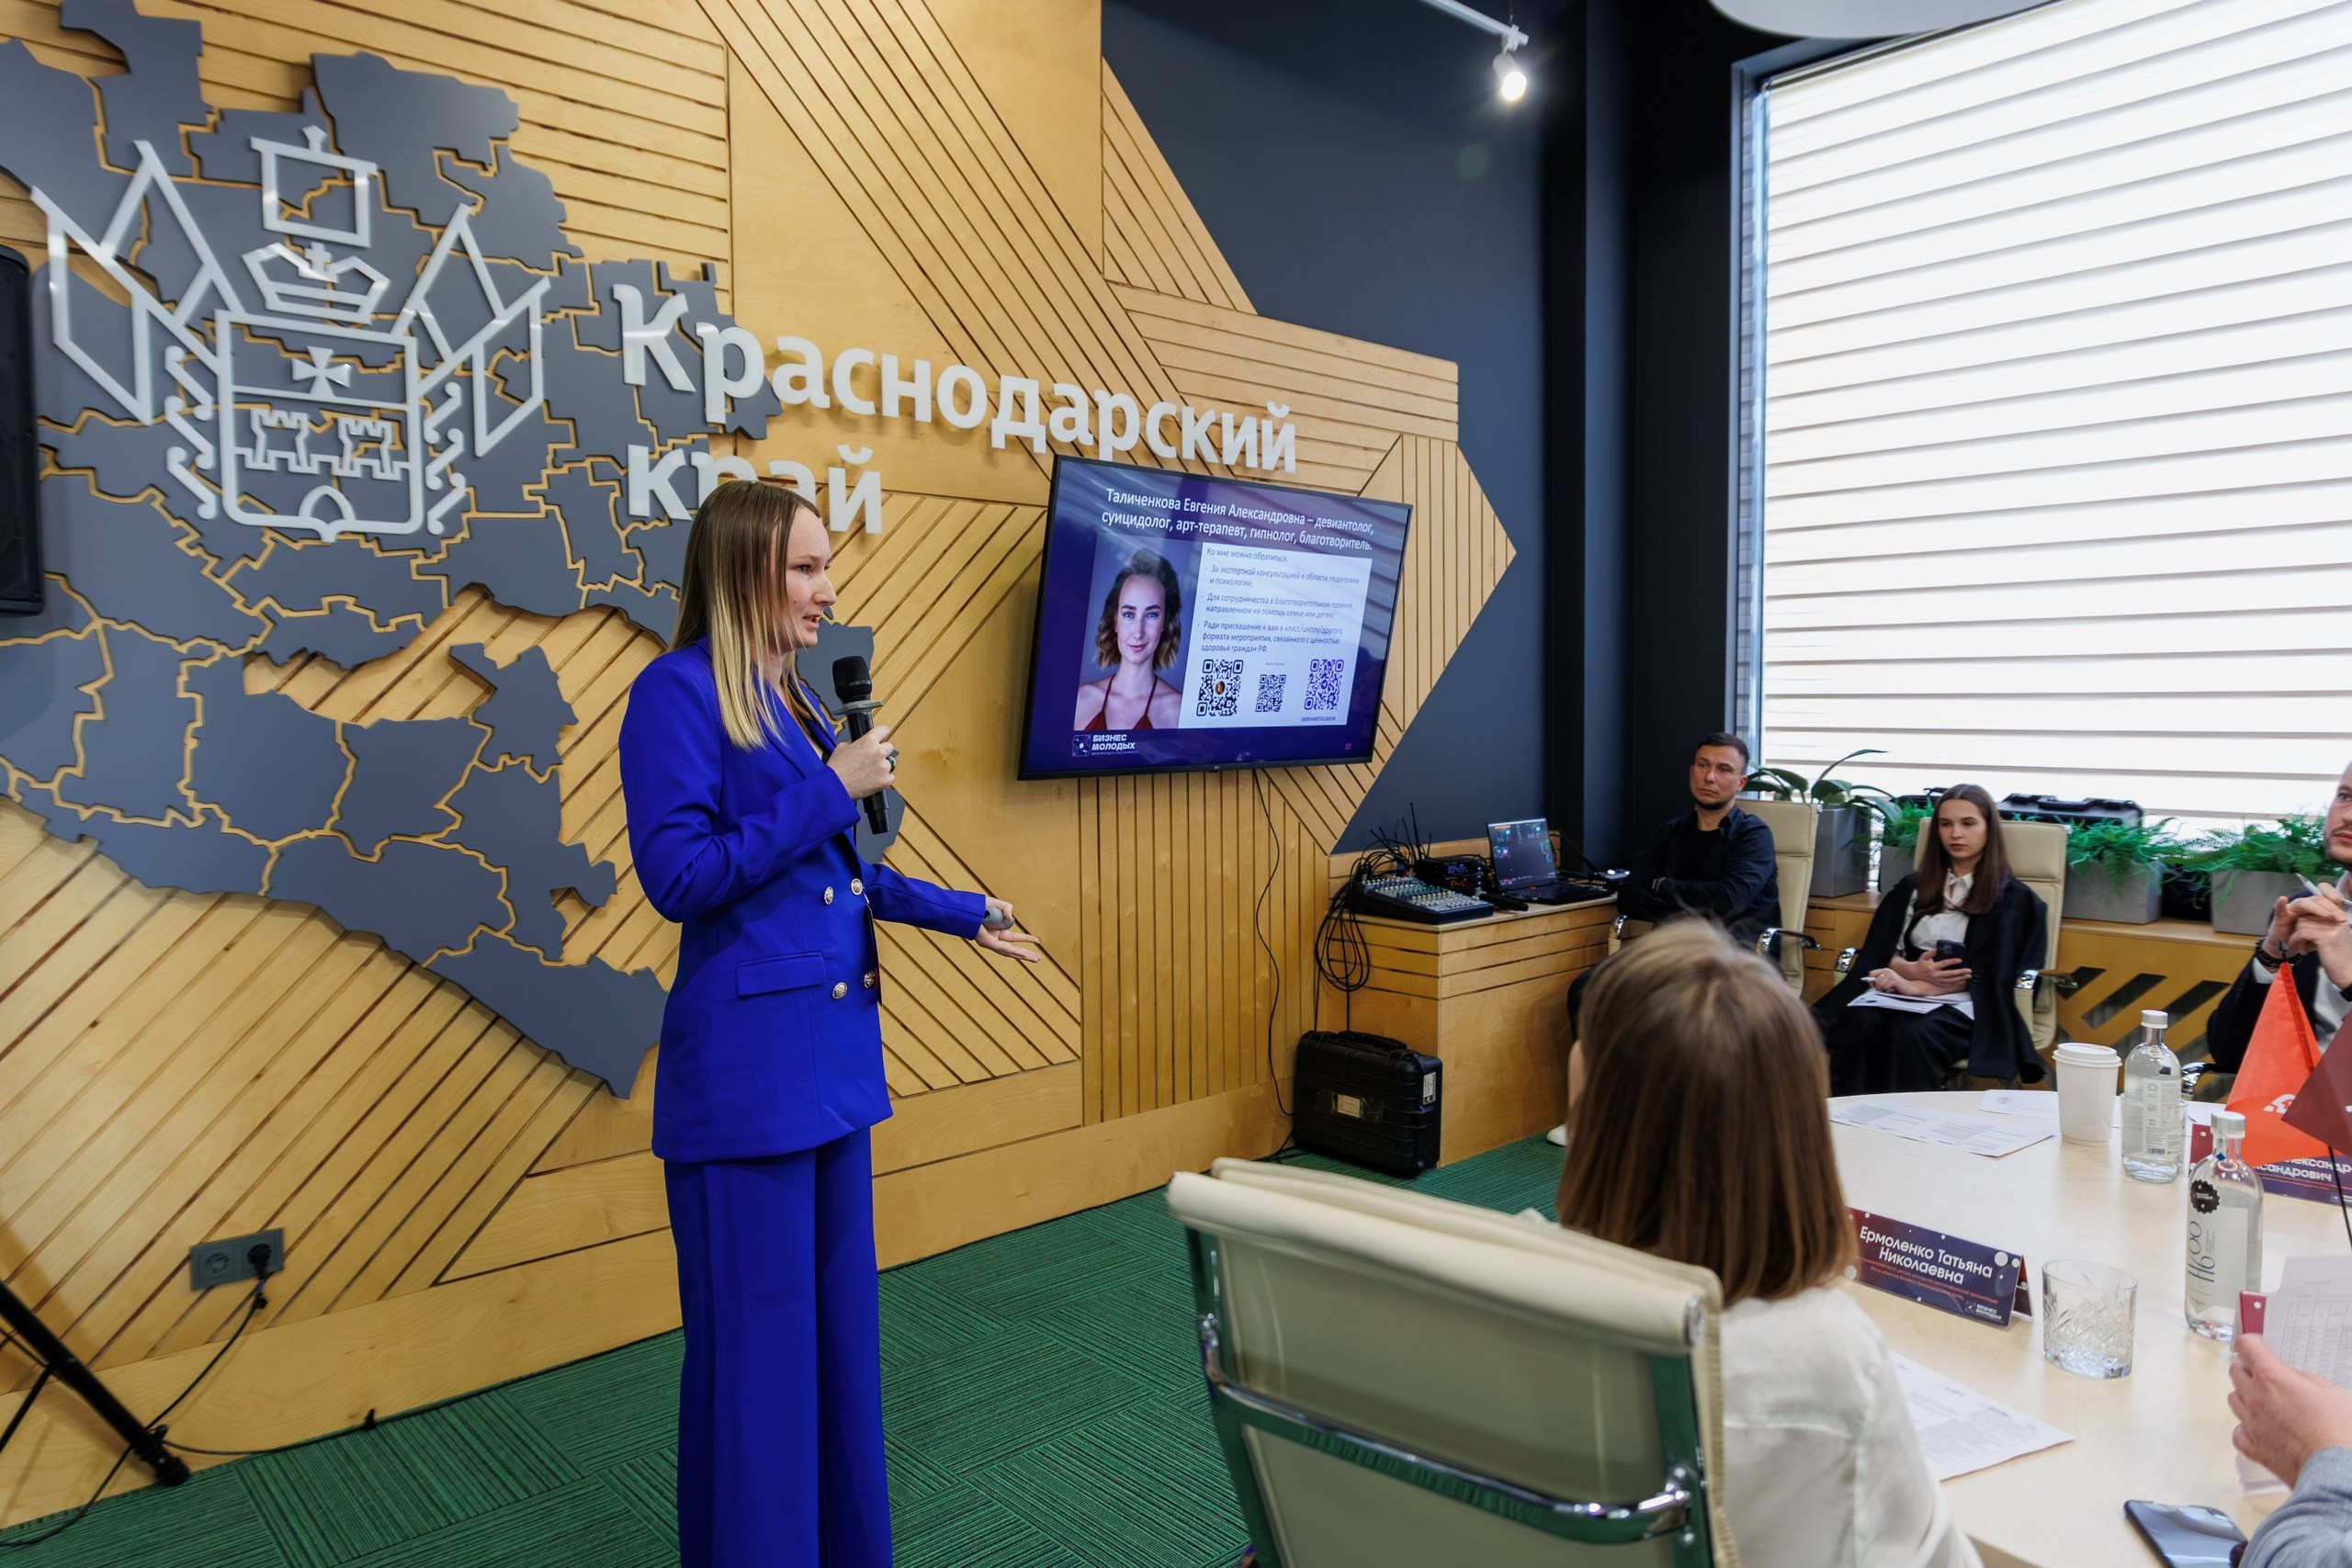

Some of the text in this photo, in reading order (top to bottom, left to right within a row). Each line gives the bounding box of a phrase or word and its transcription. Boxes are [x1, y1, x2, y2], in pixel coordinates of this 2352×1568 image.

[612, 284, 1297, 474] Краснодарский
[1106, 488, 1181, 511] Таличенкова
[1183, 498, 1226, 515] Евгения
[1228, 504, 1305, 526] Александровна
[1314, 516, 1374, 535] девиантолог,
[1102, 511, 1373, 551] суицидолог, арт-терапевт, гипнолог, благотворитель.
[1206, 547, 1215, 556] Ко
[1220, 568, 1255, 577] экспертной
[1257, 570, 1300, 580] консультацией
[1206, 593, 1219, 602] Для
[1221, 595, 1268, 604] сотрудничества
[1275, 597, 1330, 608] благотворительном
[1205, 606, 1251, 615] направленном
[1204, 621, 1219, 630] Ради
[1221, 623, 1261, 632] приглашение
[1203, 633, 1229, 641] формата
[1093, 734, 1127, 742] БИЗНЕС
[1091, 742, 1136, 750] МОЛОДЫХ
[1860, 1225, 1993, 1279] Ермоленко Татьяна
[1879, 1247, 1964, 1285] Николаевна
